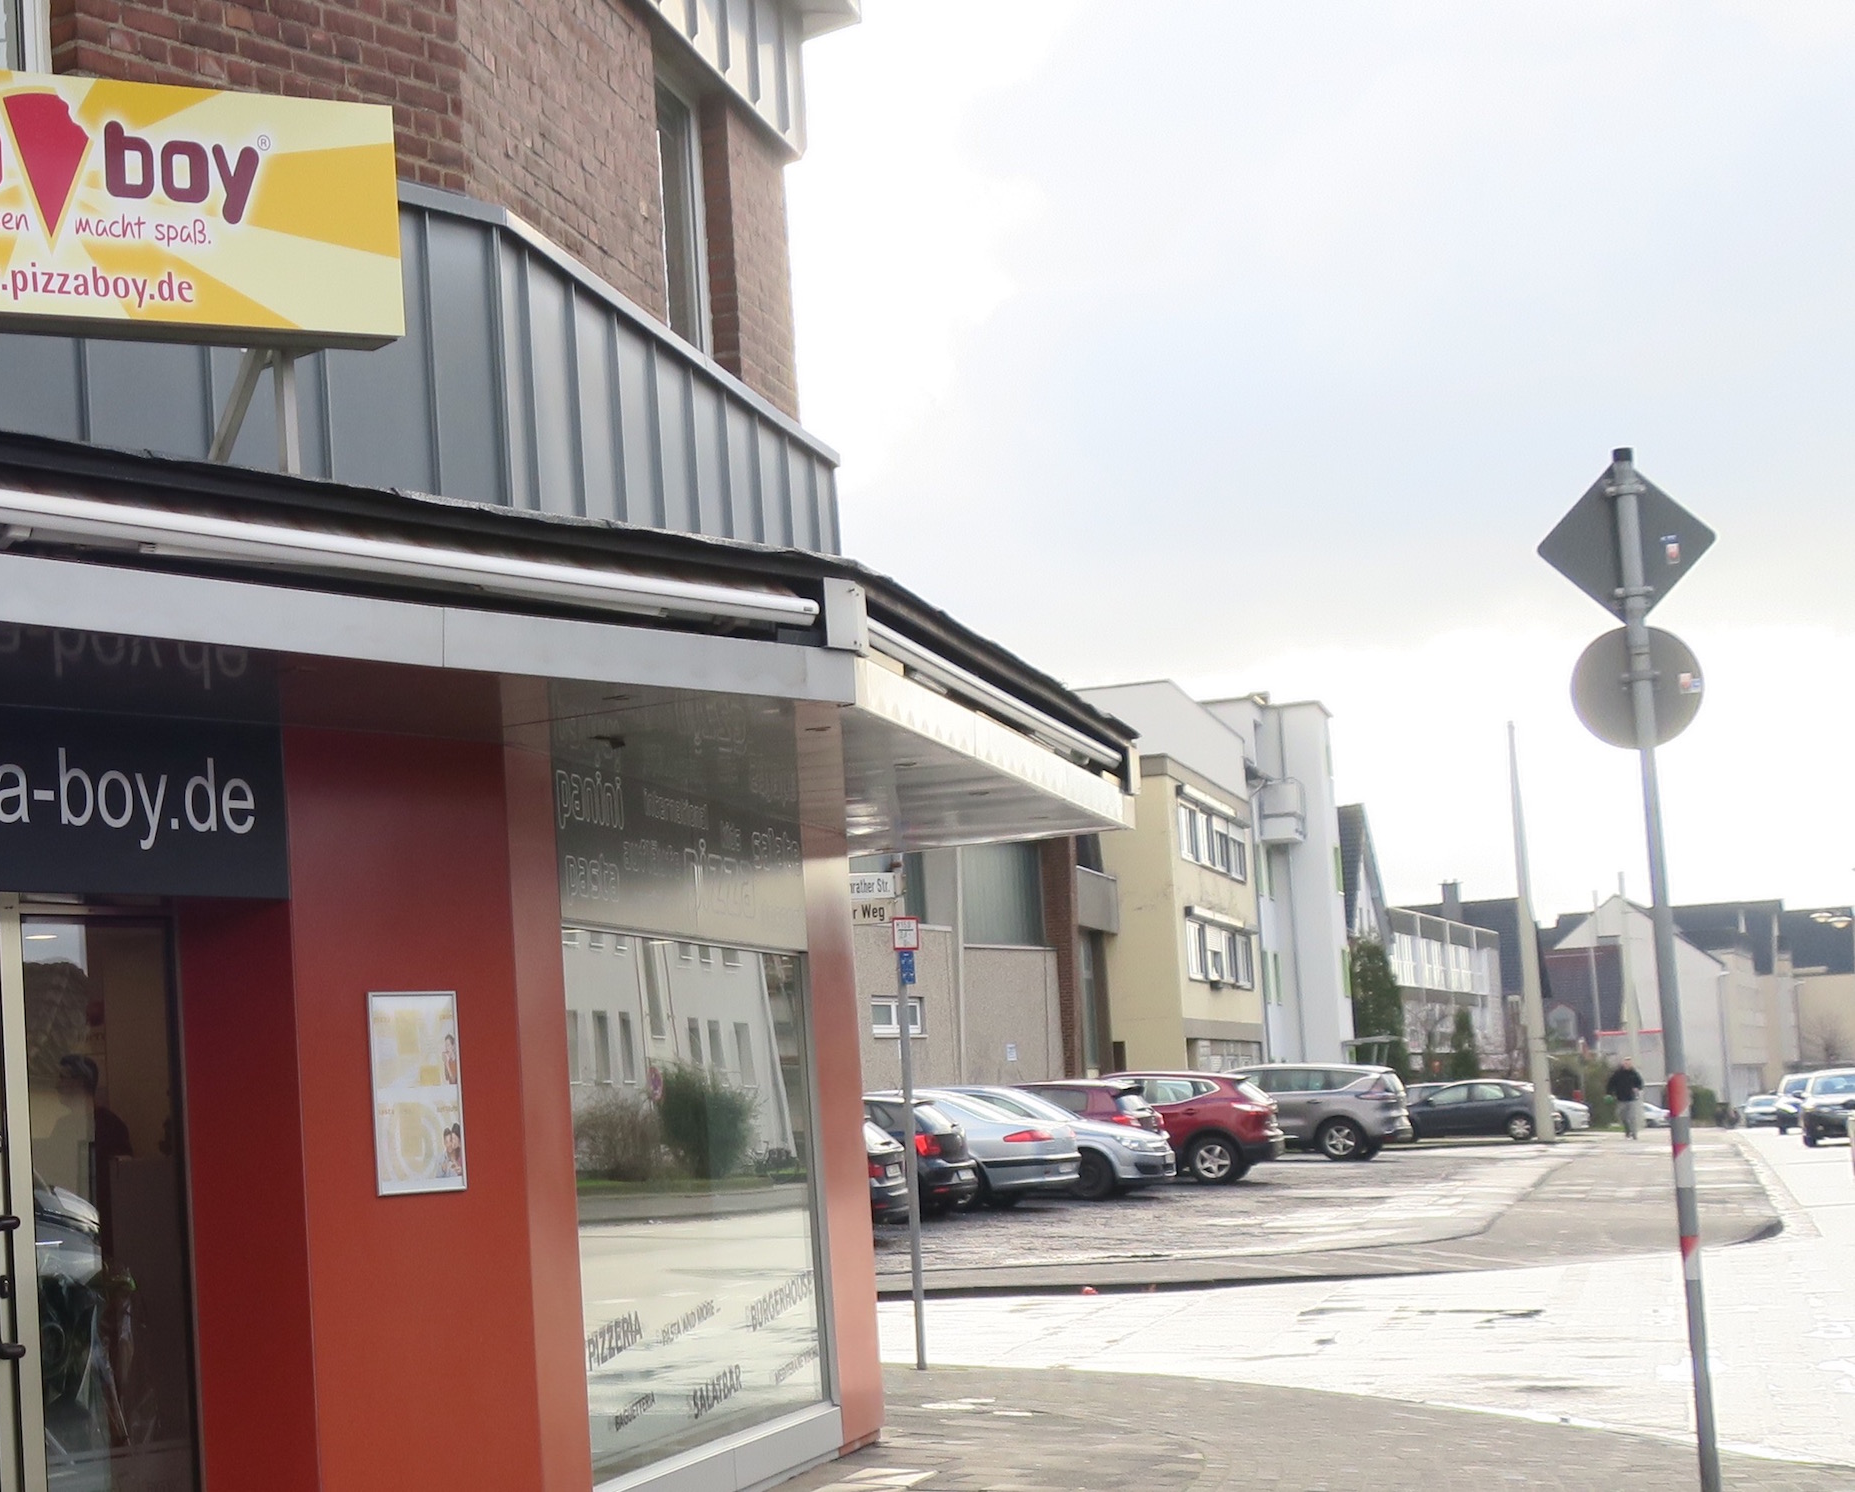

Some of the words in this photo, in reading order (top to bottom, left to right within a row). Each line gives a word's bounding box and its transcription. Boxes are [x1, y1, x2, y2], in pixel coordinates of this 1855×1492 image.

[103, 120, 259, 224] boy
[75, 214, 146, 239] macht
[556, 769, 624, 830] panini
[565, 853, 619, 906] pasta
[861, 904, 885, 922] Weg
[586, 1311, 643, 1372] PIZZERIA
[693, 1364, 743, 1420] SALATBAR
